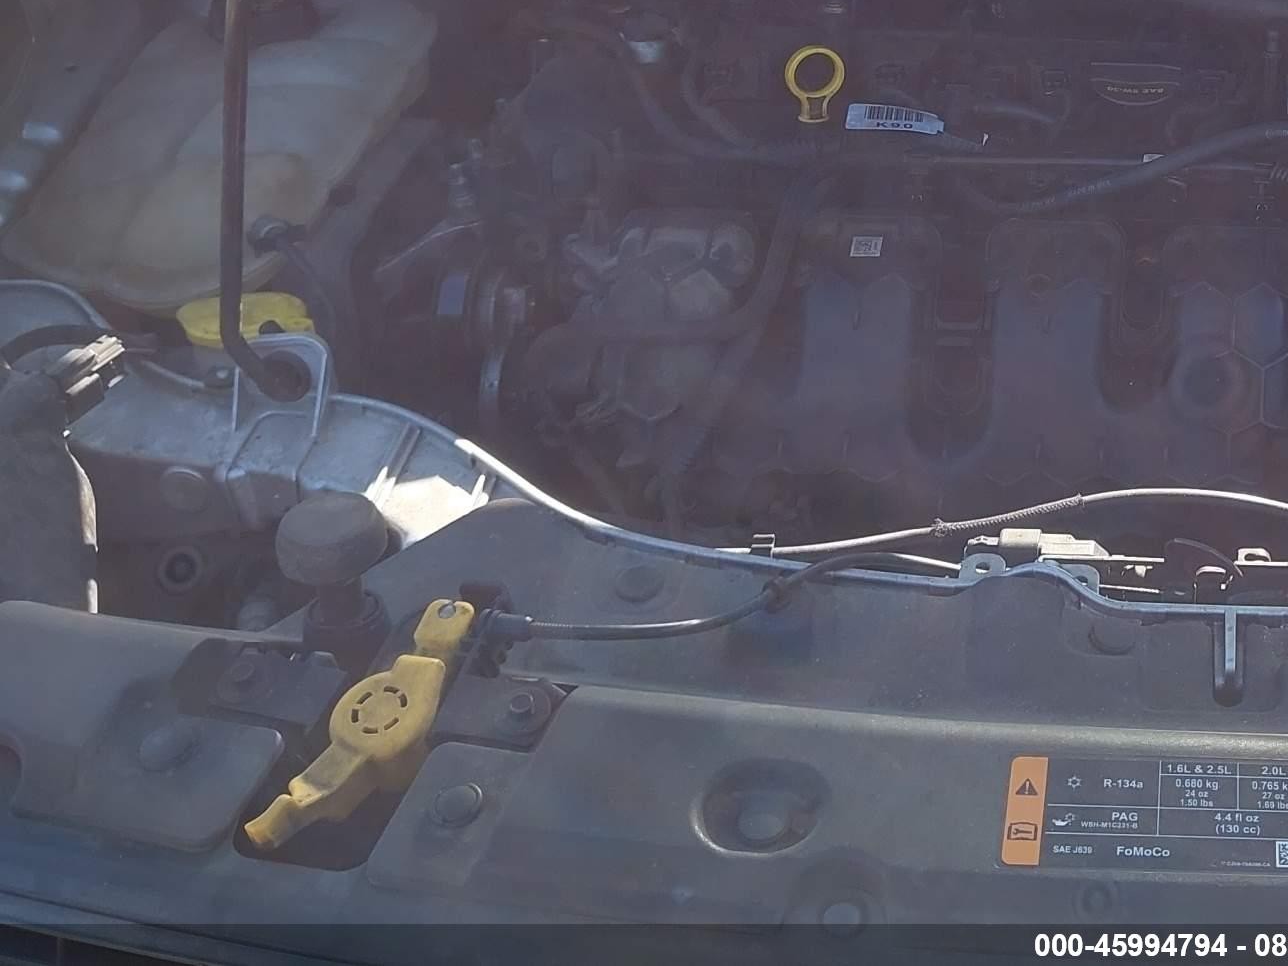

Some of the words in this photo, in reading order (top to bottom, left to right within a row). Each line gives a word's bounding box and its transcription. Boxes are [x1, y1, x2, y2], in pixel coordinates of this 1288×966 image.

[1167, 764, 1191, 774] 1.6L
[1194, 765, 1204, 774] &
[1207, 766, 1232, 775] 2.5L
[1261, 766, 1286, 776] 2.0L
[1103, 778, 1144, 789] R-134a
[1175, 778, 1203, 788] 0.680
[1206, 779, 1219, 790] kg
[1252, 781, 1279, 791] 0.765
[1185, 789, 1196, 797] 24
[1262, 792, 1272, 800] 27
[1180, 799, 1198, 807] 1.50
[1200, 799, 1213, 807] lbs
[1111, 812, 1138, 822] PAG
[1214, 813, 1231, 822] 4.4
[1235, 813, 1242, 822] fl
[1245, 815, 1260, 823] oz
[1215, 824, 1239, 835] (130
[1243, 825, 1261, 836] cc)
[1052, 844, 1071, 854] SAE
[1115, 846, 1171, 857] FoMoCo
